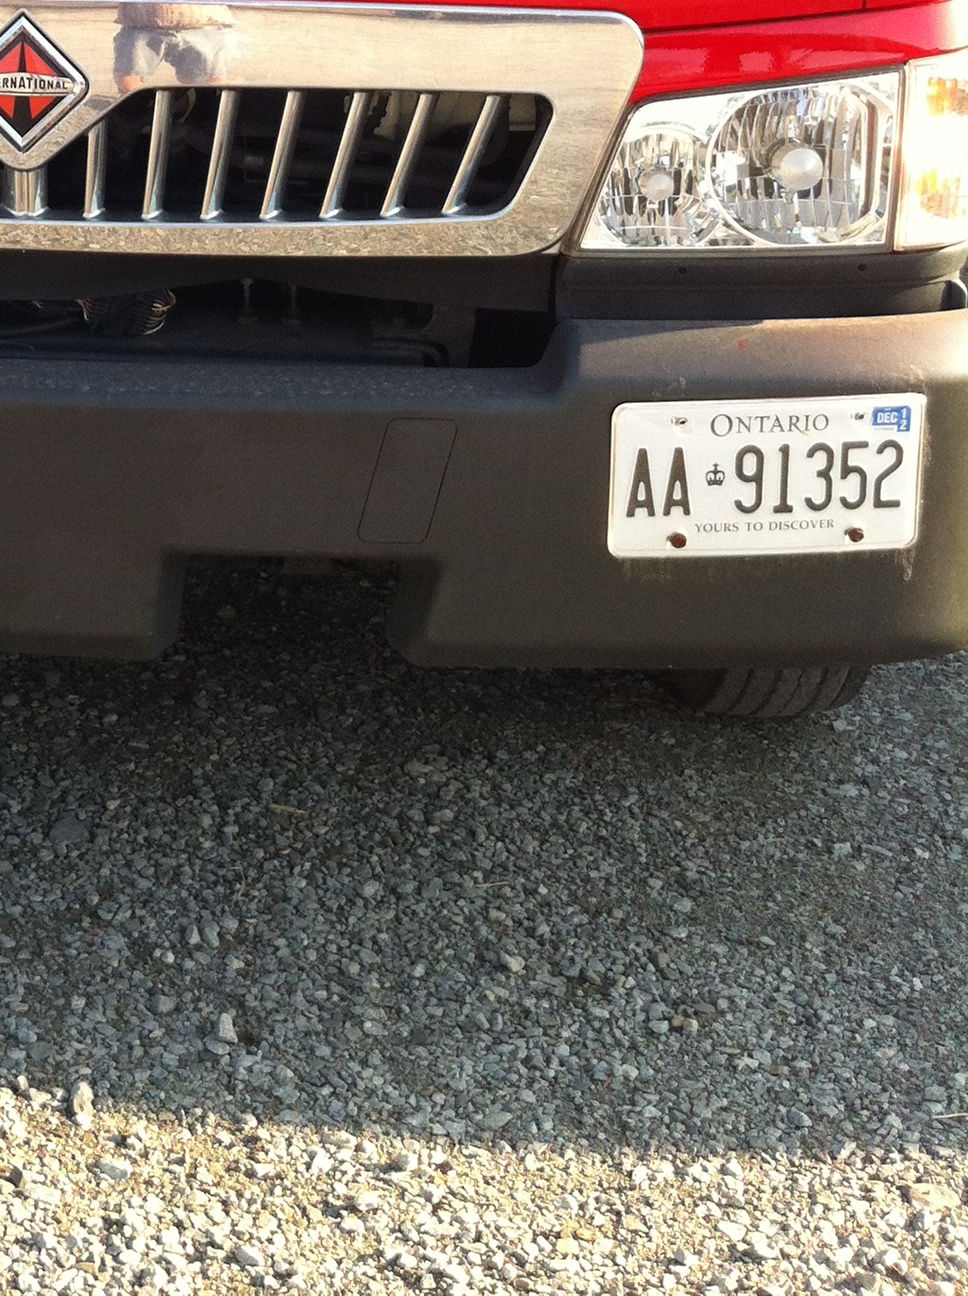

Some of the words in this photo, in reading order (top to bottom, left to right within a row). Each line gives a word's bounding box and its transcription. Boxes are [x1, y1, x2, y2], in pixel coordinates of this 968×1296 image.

[710, 413, 829, 437] ONTARIO
[877, 412, 898, 423] DEC
[626, 447, 690, 517] AA
[734, 439, 904, 514] 91352
[694, 522, 739, 533] YOURS
[745, 522, 763, 531] TO
[768, 519, 834, 531] DISCOVER
